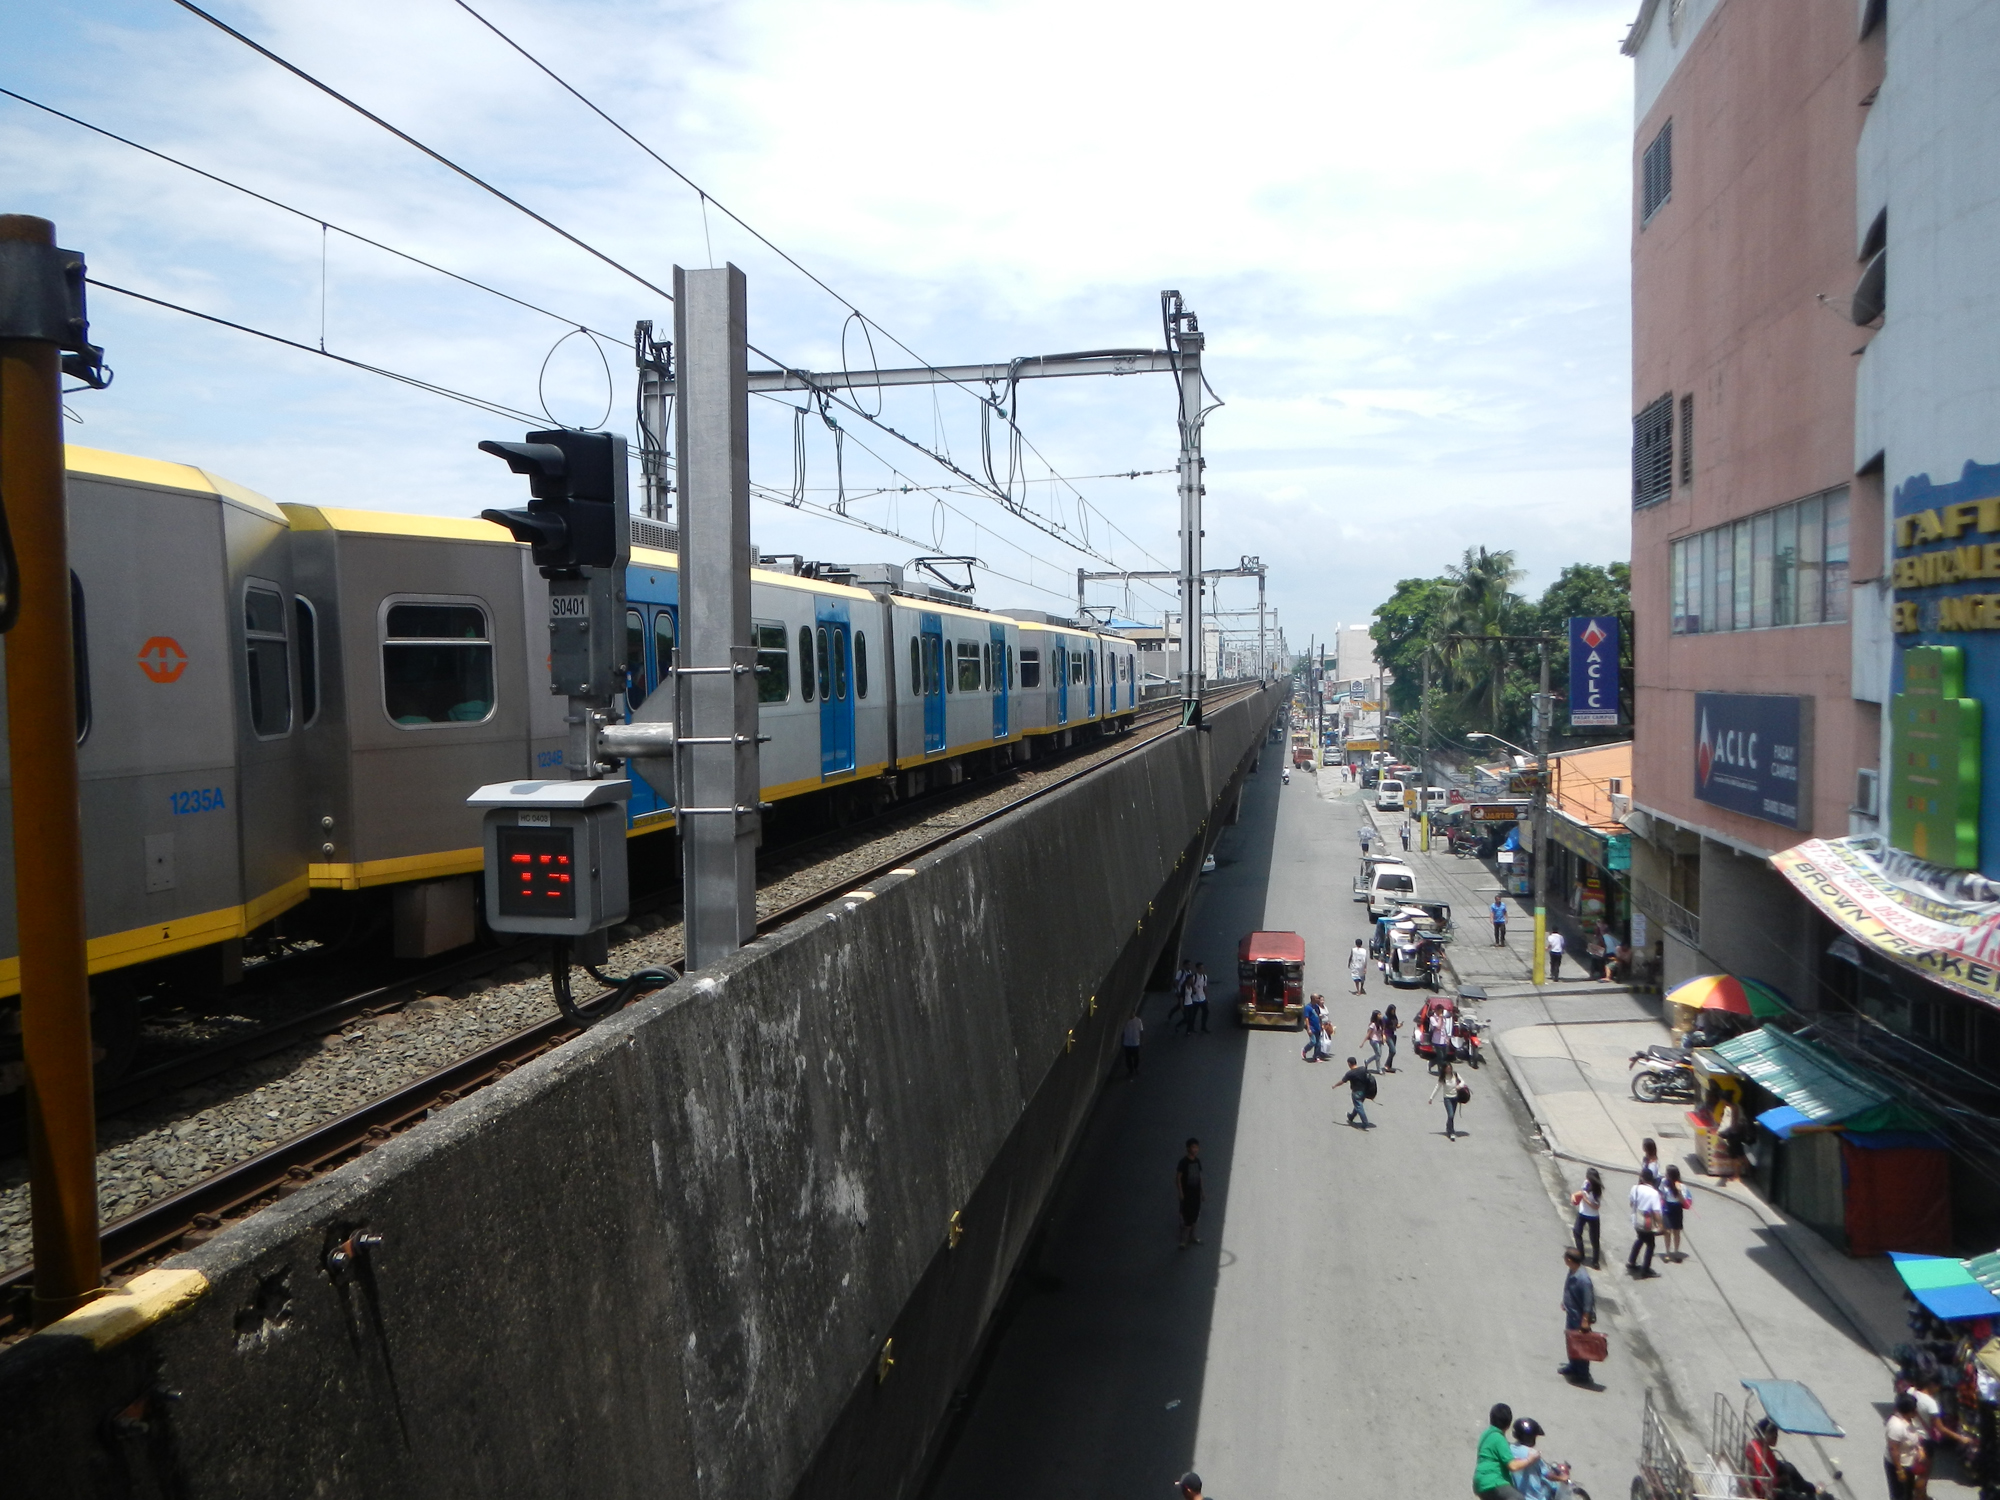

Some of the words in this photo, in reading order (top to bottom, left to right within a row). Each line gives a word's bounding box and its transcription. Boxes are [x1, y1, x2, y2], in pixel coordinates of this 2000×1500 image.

[552, 598, 586, 616] S0401
[1586, 650, 1601, 708] ACLC
[536, 750, 563, 768] 1234B
[1714, 729, 1757, 769] ACLC
[169, 787, 226, 815] 1235A
[520, 814, 531, 822] HC
[1794, 862, 1872, 923] BROWN
